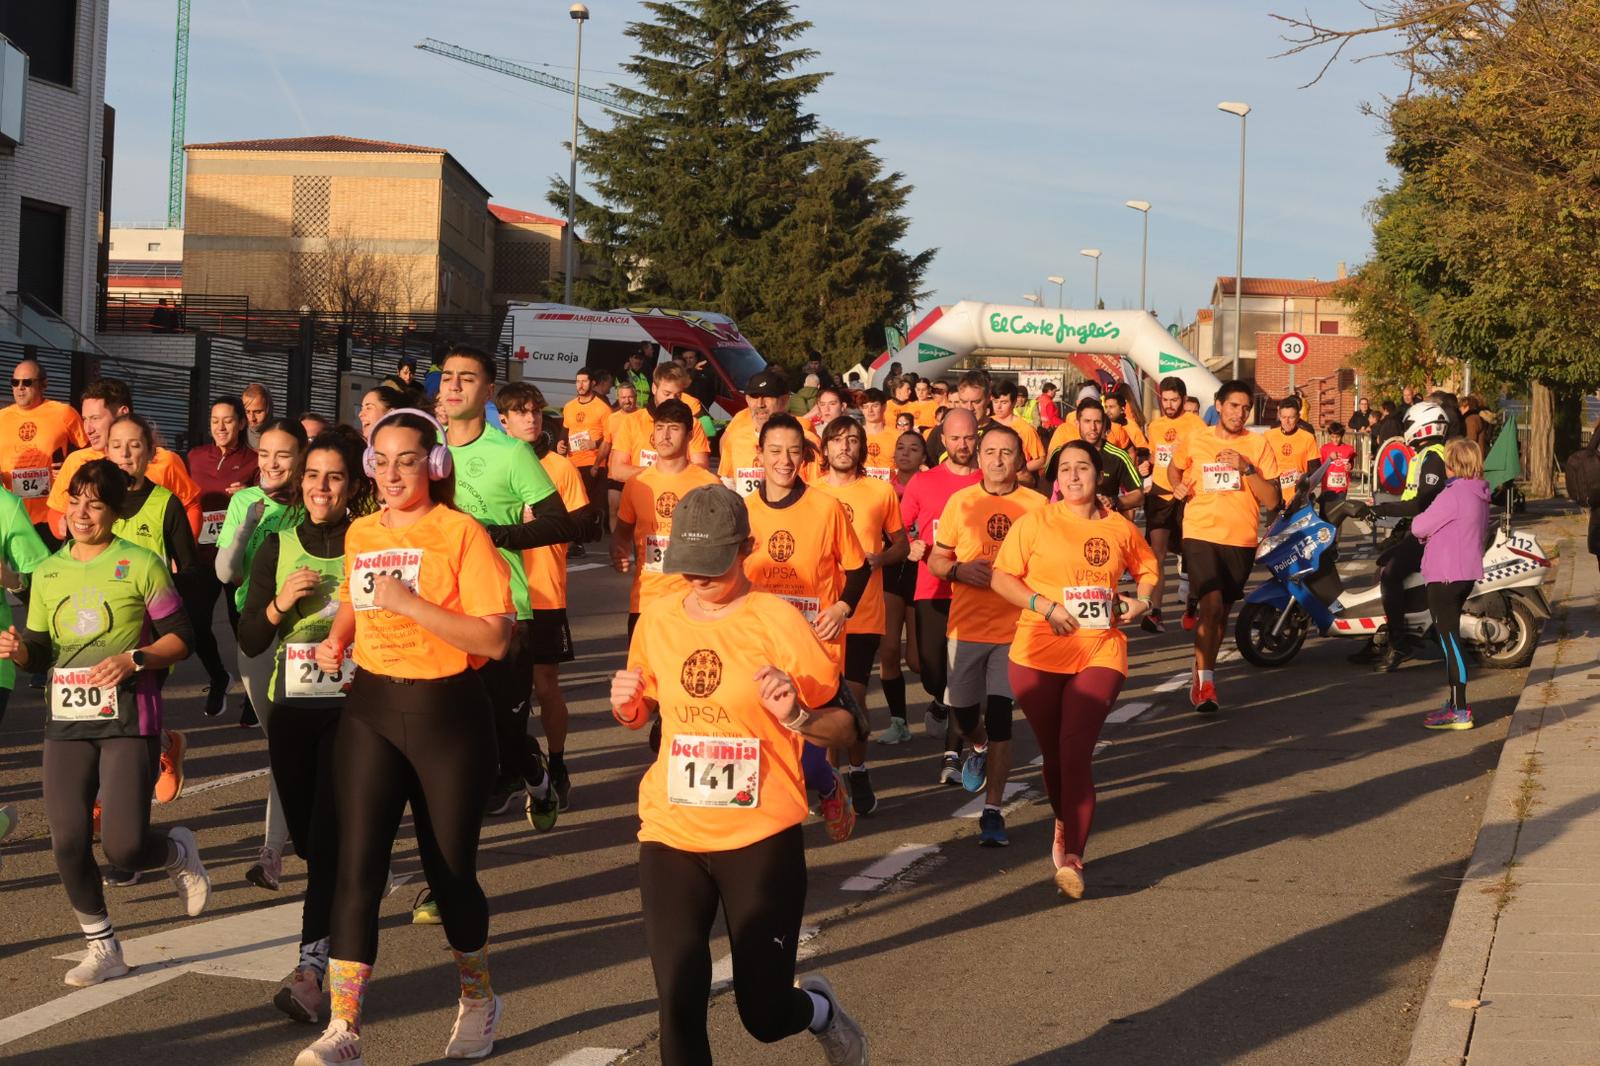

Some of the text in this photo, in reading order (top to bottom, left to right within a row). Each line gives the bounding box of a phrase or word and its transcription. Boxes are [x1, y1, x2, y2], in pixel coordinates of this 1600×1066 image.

[574, 314, 629, 325] AMBULANCIA
[990, 312, 1120, 344] El Corte Inglés
[1284, 343, 1302, 354] 30
[532, 351, 579, 364] Cruz Roja
[23, 480, 39, 491] 84
[1214, 472, 1230, 484] 70
[1511, 536, 1533, 552] 112
[354, 552, 420, 571] bedunia
[763, 567, 798, 579] UPSA
[1075, 570, 1108, 583] UPSA
[1078, 601, 1109, 618] 251
[61, 686, 102, 707] 230
[675, 706, 731, 724] UPSA
[671, 739, 758, 761] bedunia
[684, 762, 735, 790] 141
